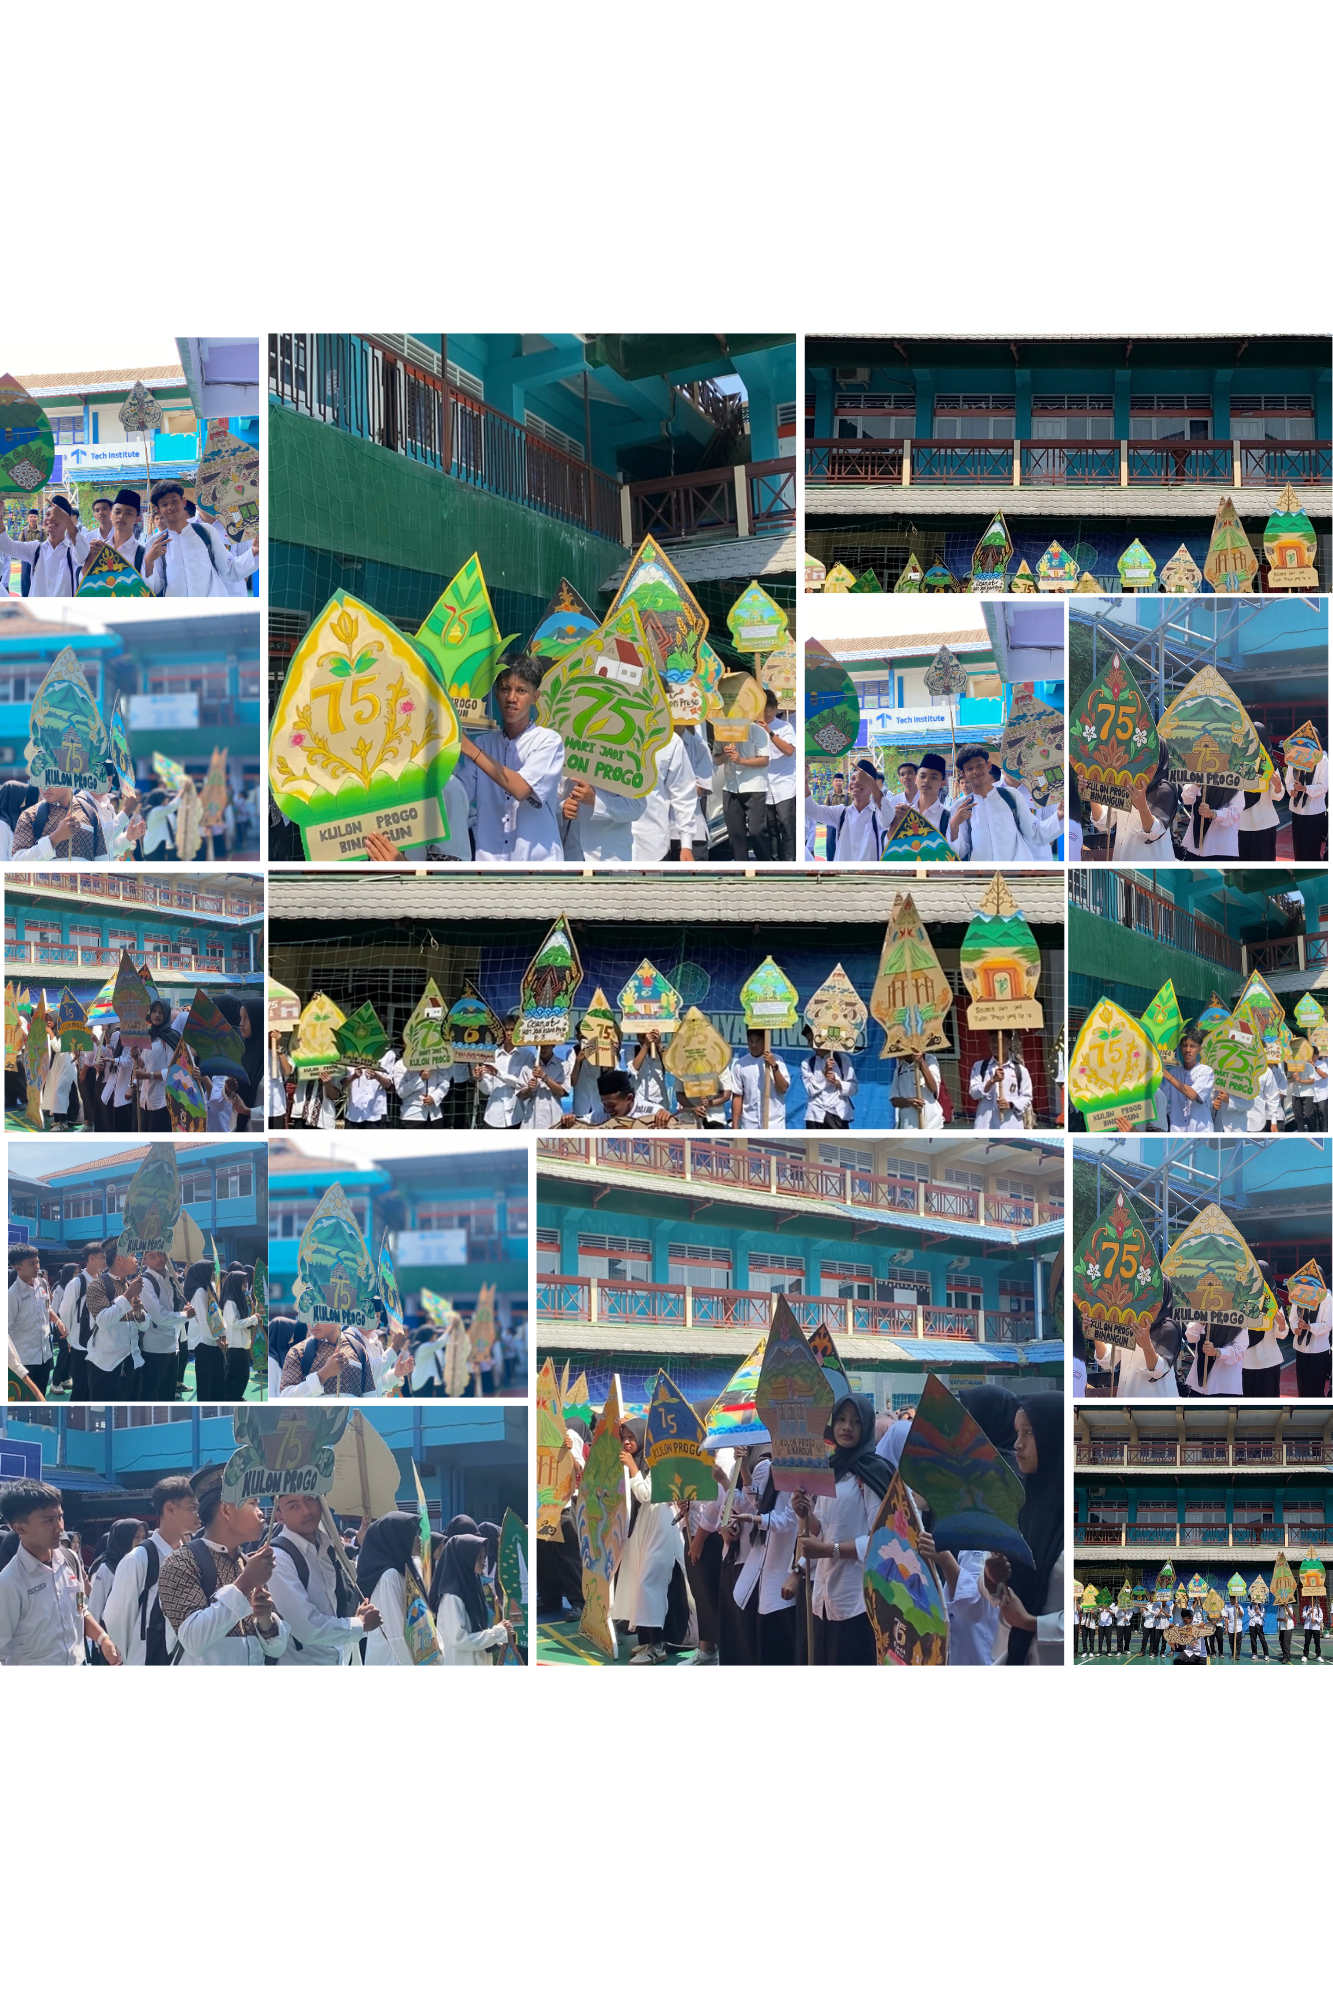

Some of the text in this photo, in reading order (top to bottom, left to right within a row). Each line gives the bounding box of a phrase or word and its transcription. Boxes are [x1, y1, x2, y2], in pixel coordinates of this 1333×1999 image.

[109, 450, 140, 458] Institute
[310, 673, 382, 734] 75
[573, 686, 654, 745] 75
[896, 714, 945, 724] Tech Institute
[1098, 703, 1136, 740] 75
[62, 741, 82, 774] 75
[564, 736, 625, 762] HARI JADI
[1196, 748, 1220, 773] 75
[45, 768, 98, 790] KULON PROGO
[594, 761, 644, 789] PROGO
[1086, 780, 1109, 792] KULON
[1170, 770, 1240, 786] KULON PROGO
[1090, 792, 1124, 808] BINANGUN
[318, 807, 418, 842] KULON PROGO
[339, 826, 413, 854] BINAGUN
[420, 1023, 443, 1049] 75
[596, 1024, 613, 1040] 75
[410, 1059, 430, 1067] KULON
[432, 1056, 451, 1065] PROGO
[1089, 1038, 1124, 1068] 75
[1218, 1044, 1259, 1073] 75
[1228, 1081, 1253, 1095] PROGO
[1093, 1104, 1142, 1121] KULON PROGO
[1102, 1242, 1140, 1278] 75
[330, 1278, 351, 1310] 75
[1200, 1286, 1224, 1311] 75
[314, 1304, 366, 1326] KULON PROGO
[1090, 1320, 1113, 1332] KULON
[1174, 1308, 1244, 1325] KULON PROGO
[1094, 1330, 1128, 1347] BINANGUN
[275, 1420, 307, 1470] 75
[652, 1442, 702, 1460] KULON PROGO
[780, 1439, 815, 1447] KULON PROGO
[242, 1469, 318, 1498] KULON PROGO
